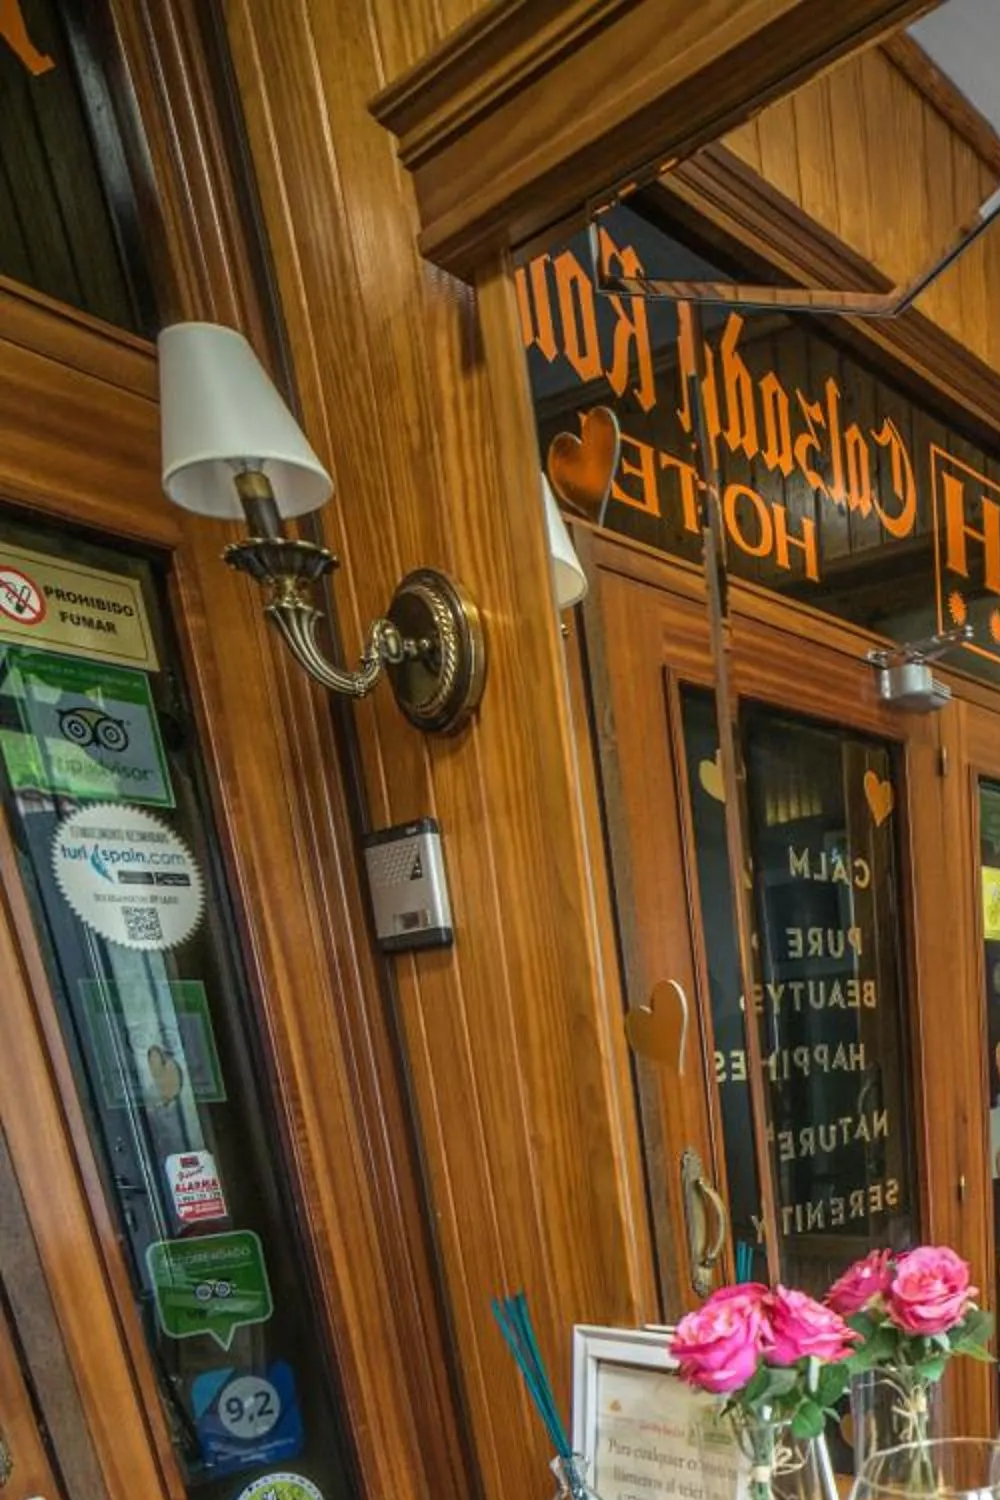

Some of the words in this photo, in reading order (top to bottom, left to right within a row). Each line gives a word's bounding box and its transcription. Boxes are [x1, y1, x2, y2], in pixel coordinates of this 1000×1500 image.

[42, 584, 136, 618] PROHIBIDO
[59, 611, 119, 636] FUMAR
[225, 1390, 276, 1425] 9,2
